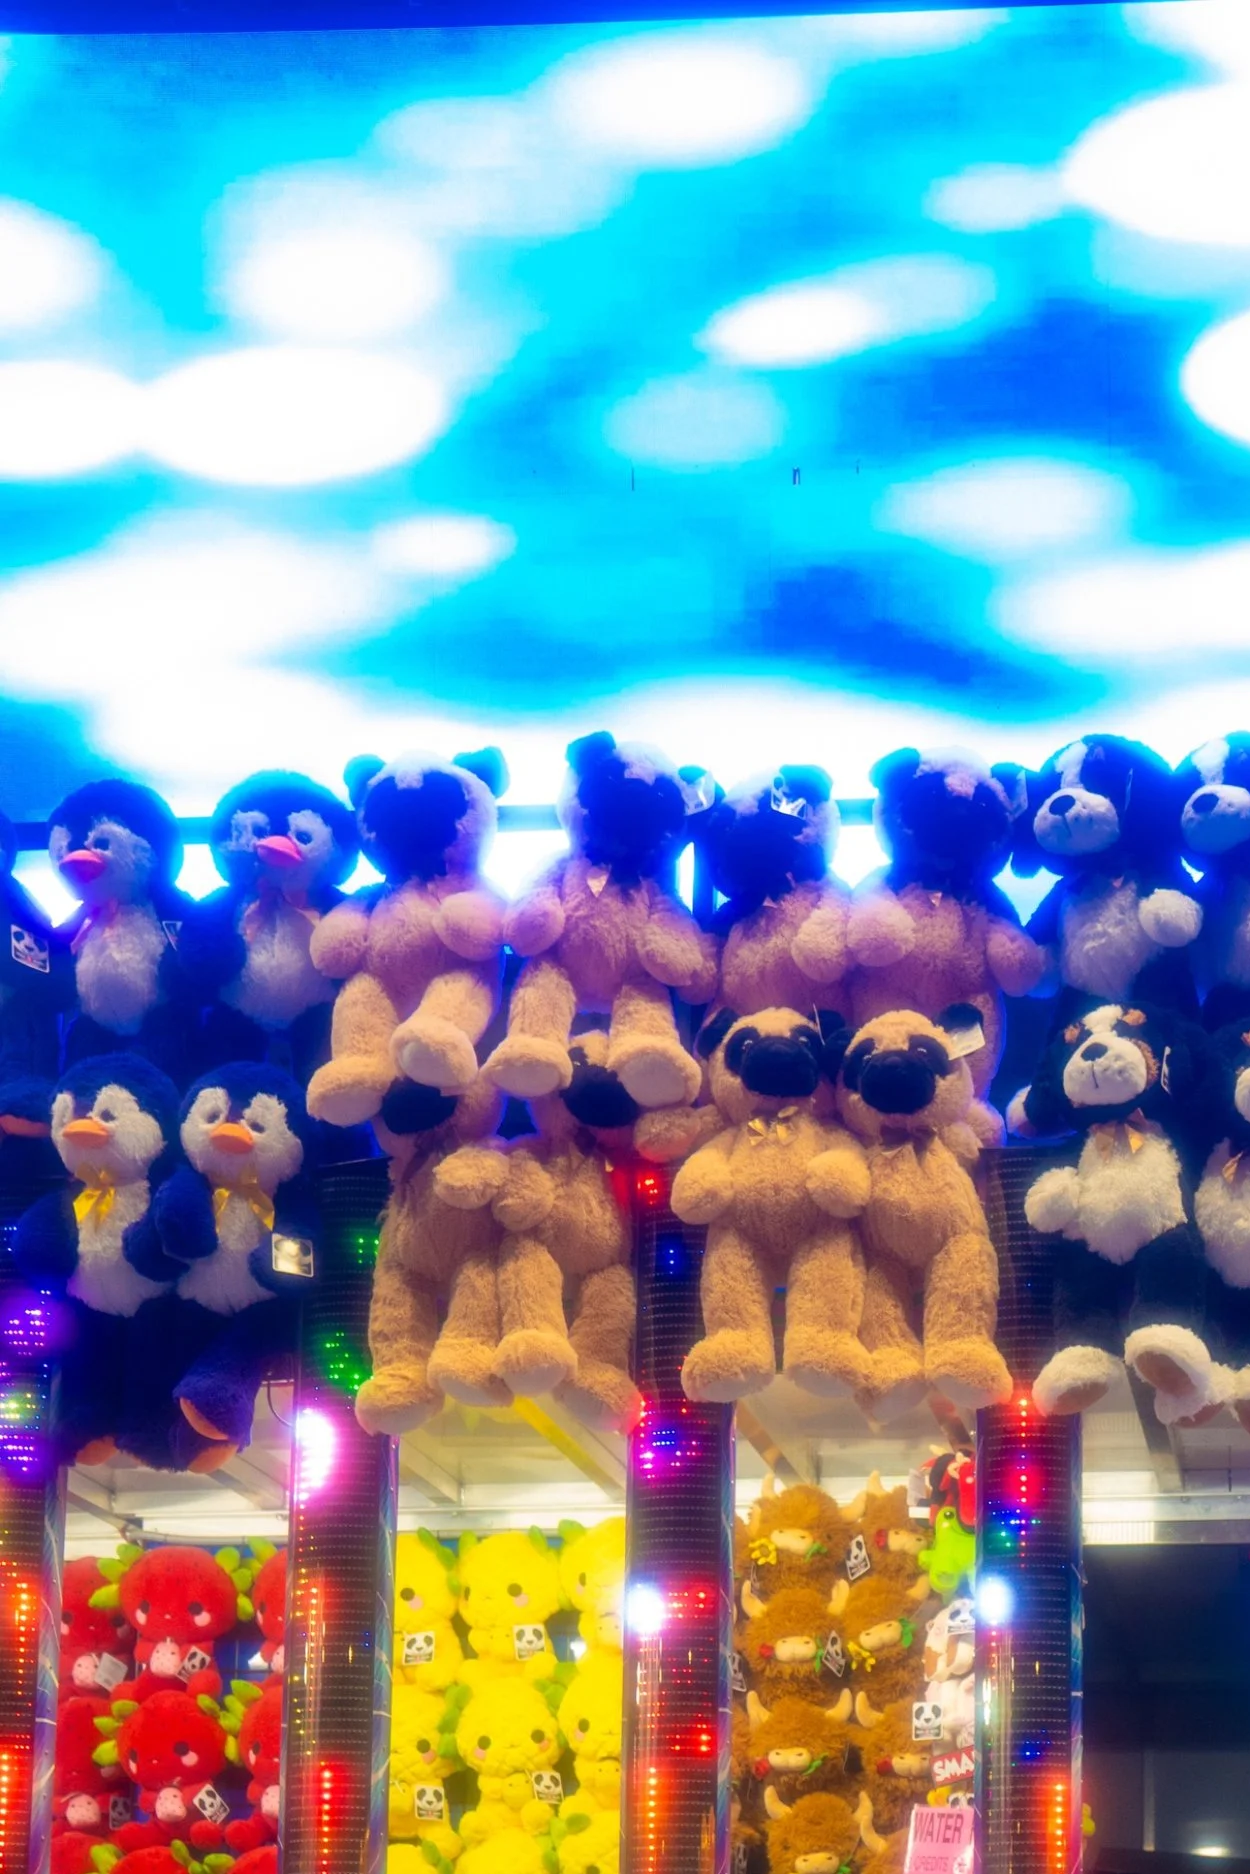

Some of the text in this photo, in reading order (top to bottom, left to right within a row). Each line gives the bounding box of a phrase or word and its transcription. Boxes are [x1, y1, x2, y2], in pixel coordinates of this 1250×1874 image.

[933, 1749, 975, 1782] SMA
[913, 1811, 964, 1845] WATER
[913, 1856, 949, 1873] CREDITS
